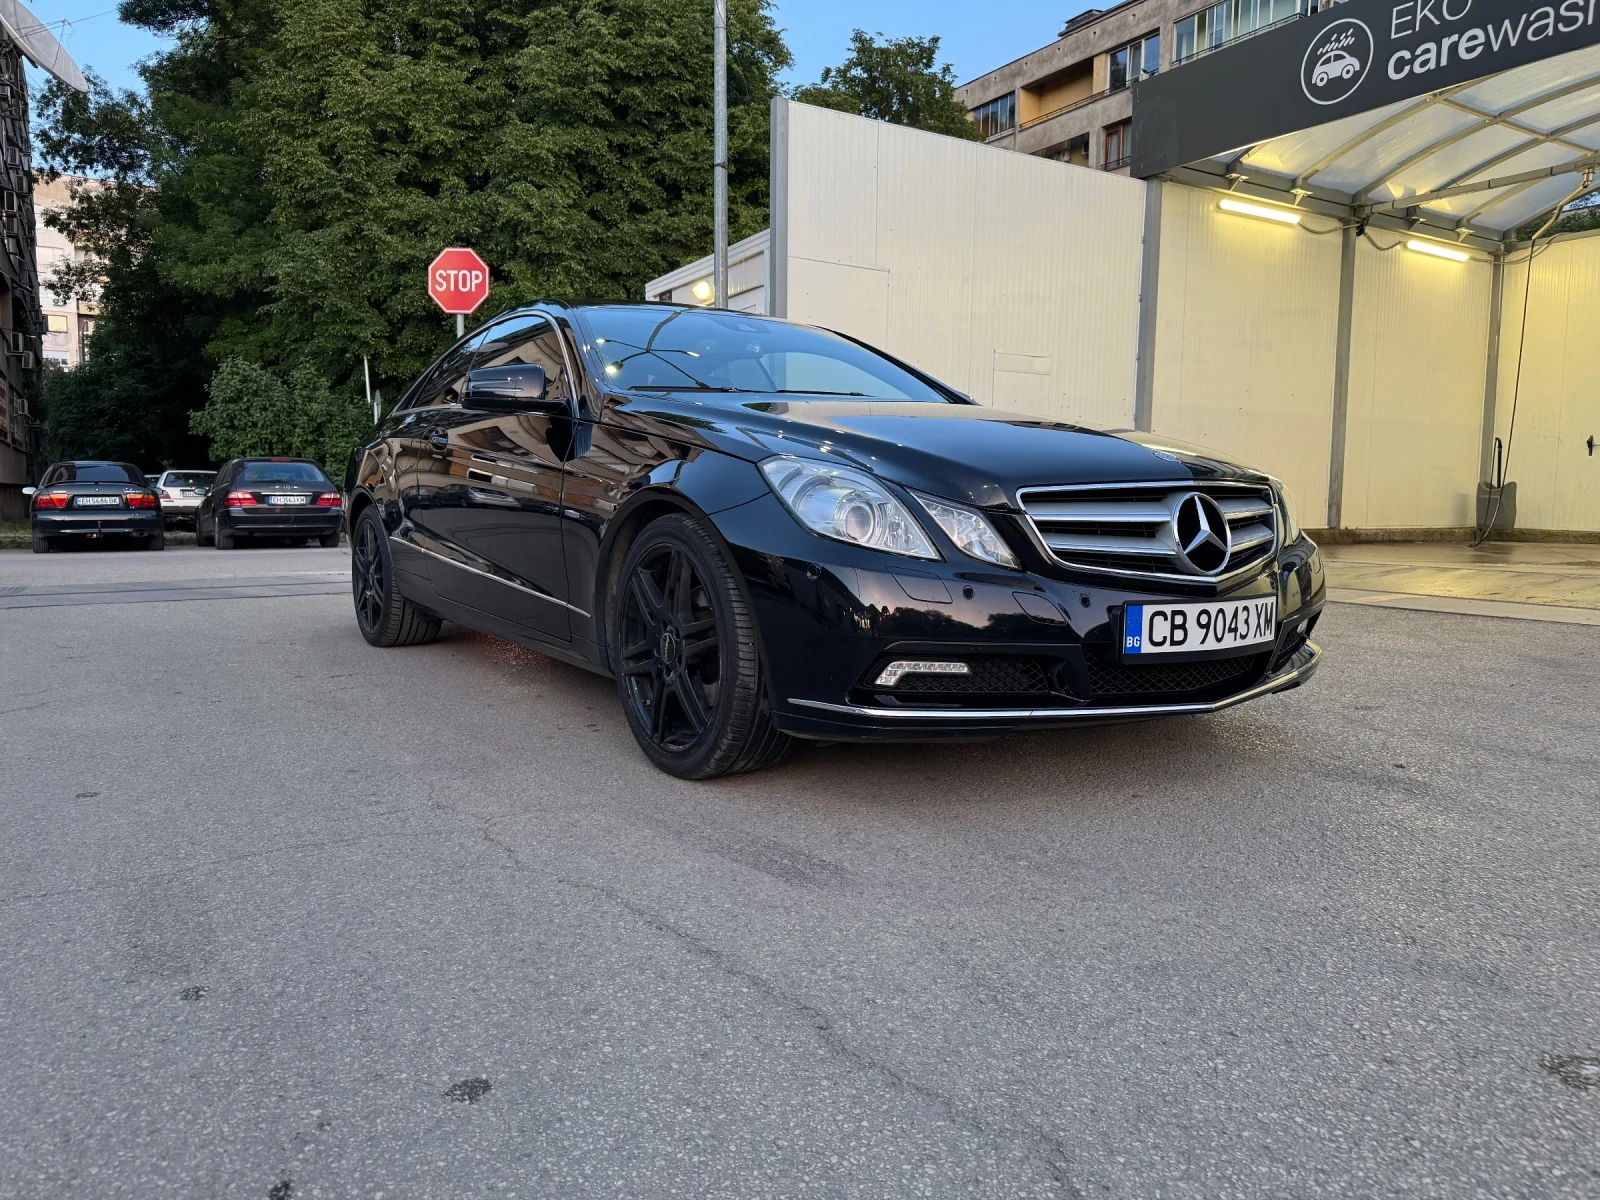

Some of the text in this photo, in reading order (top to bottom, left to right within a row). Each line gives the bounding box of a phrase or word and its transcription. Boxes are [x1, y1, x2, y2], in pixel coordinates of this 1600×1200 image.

[1391, 0, 1472, 39] EKO
[435, 269, 483, 293] STOP
[1148, 601, 1274, 647] CB 9043 XM
[1126, 636, 1141, 648] BG
